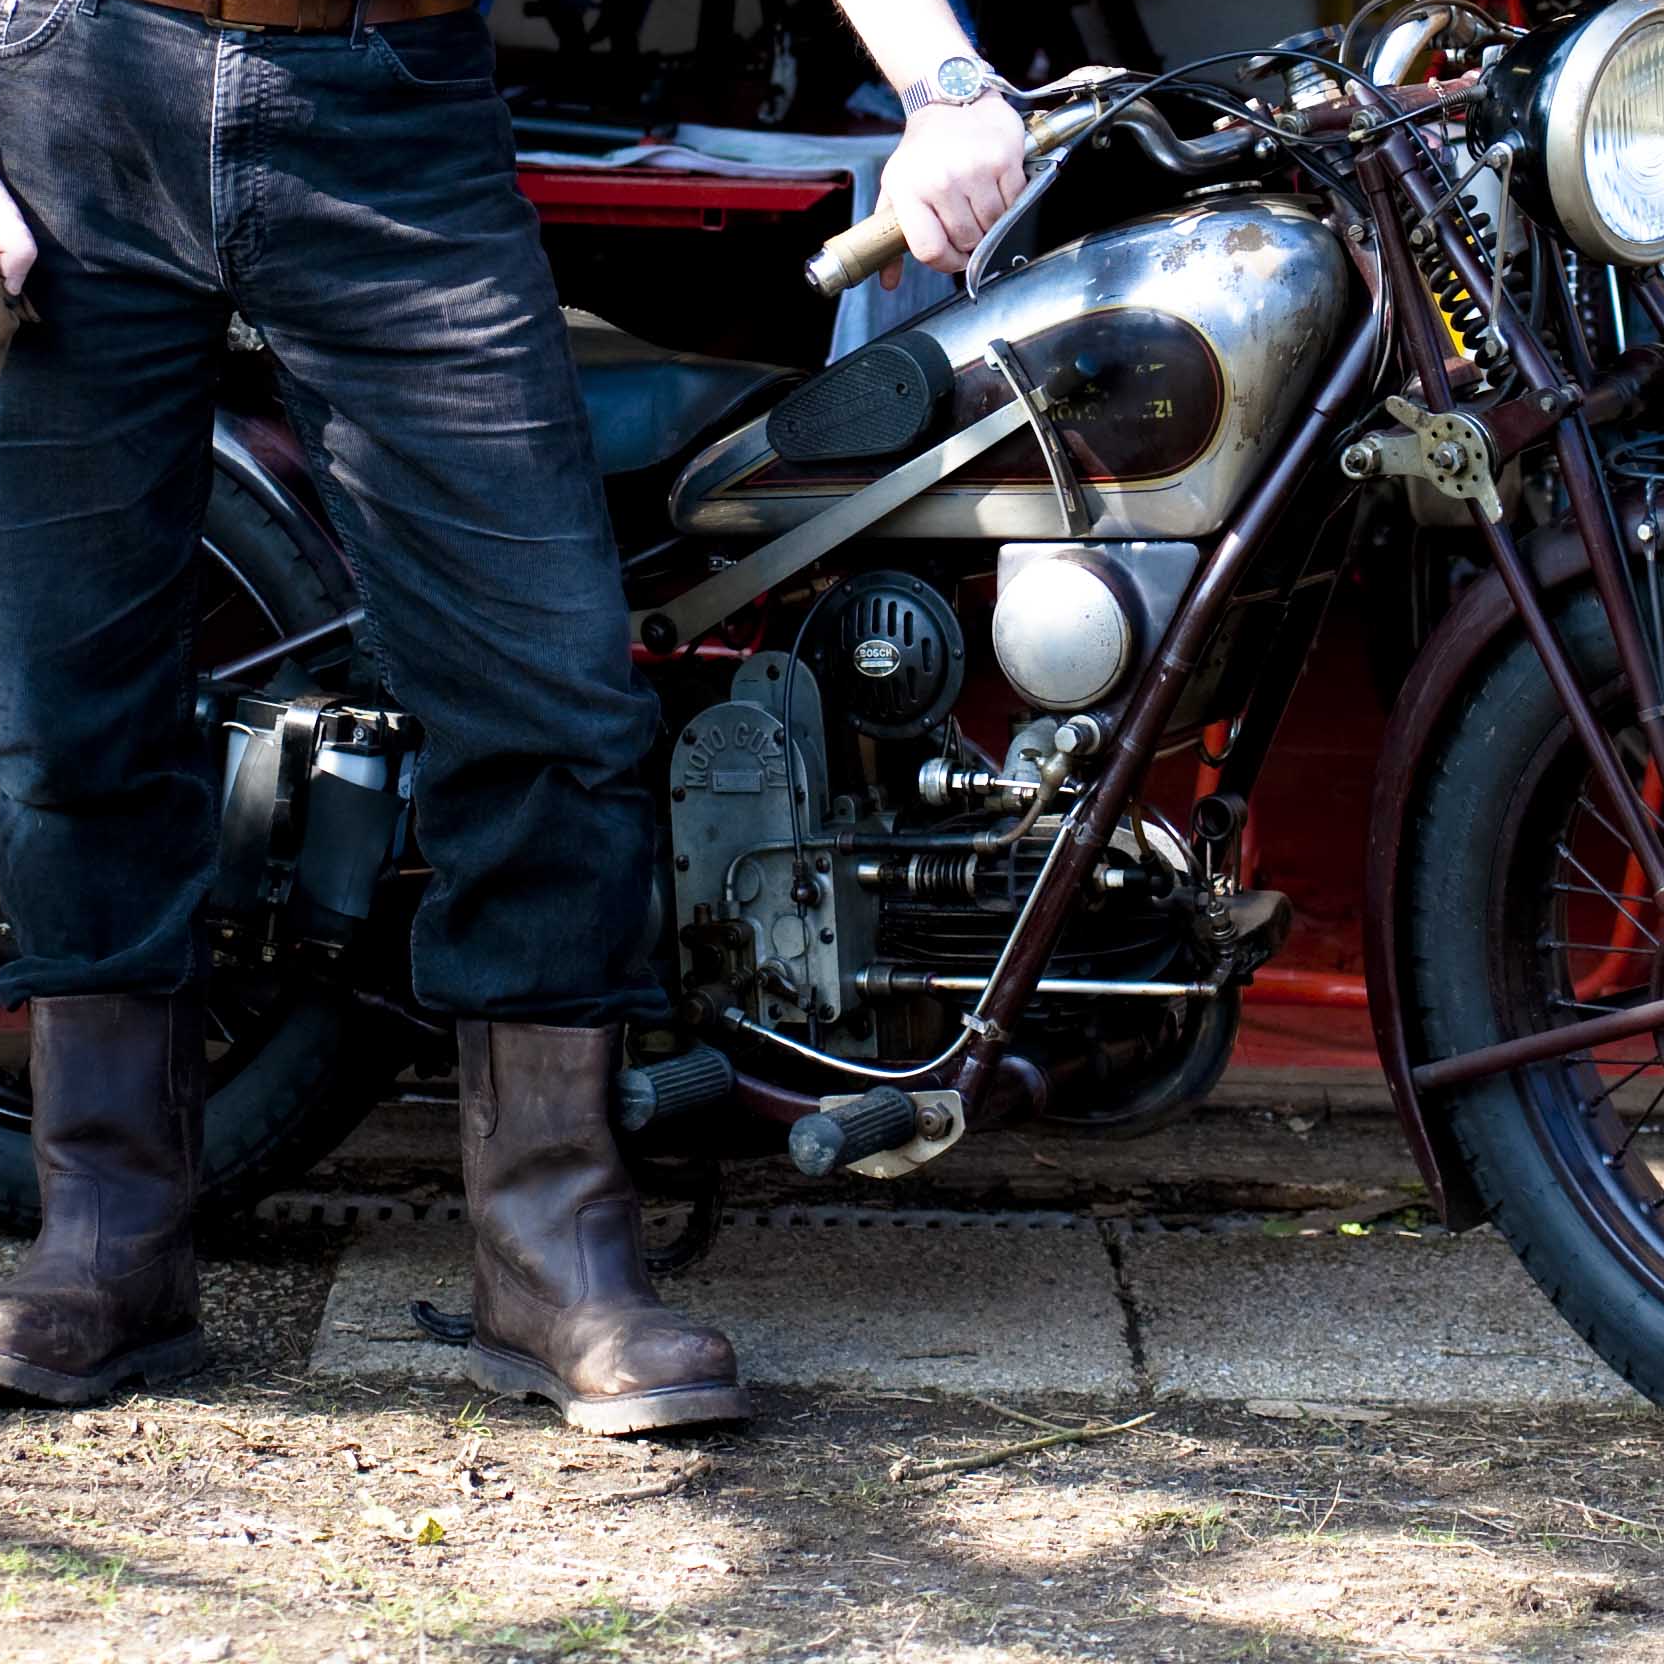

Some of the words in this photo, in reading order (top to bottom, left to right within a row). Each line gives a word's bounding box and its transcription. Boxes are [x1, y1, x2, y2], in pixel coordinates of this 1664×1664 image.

[859, 648, 893, 658] BOSCH
[685, 725, 726, 788] MOTO
[736, 721, 790, 788] GUZZI
